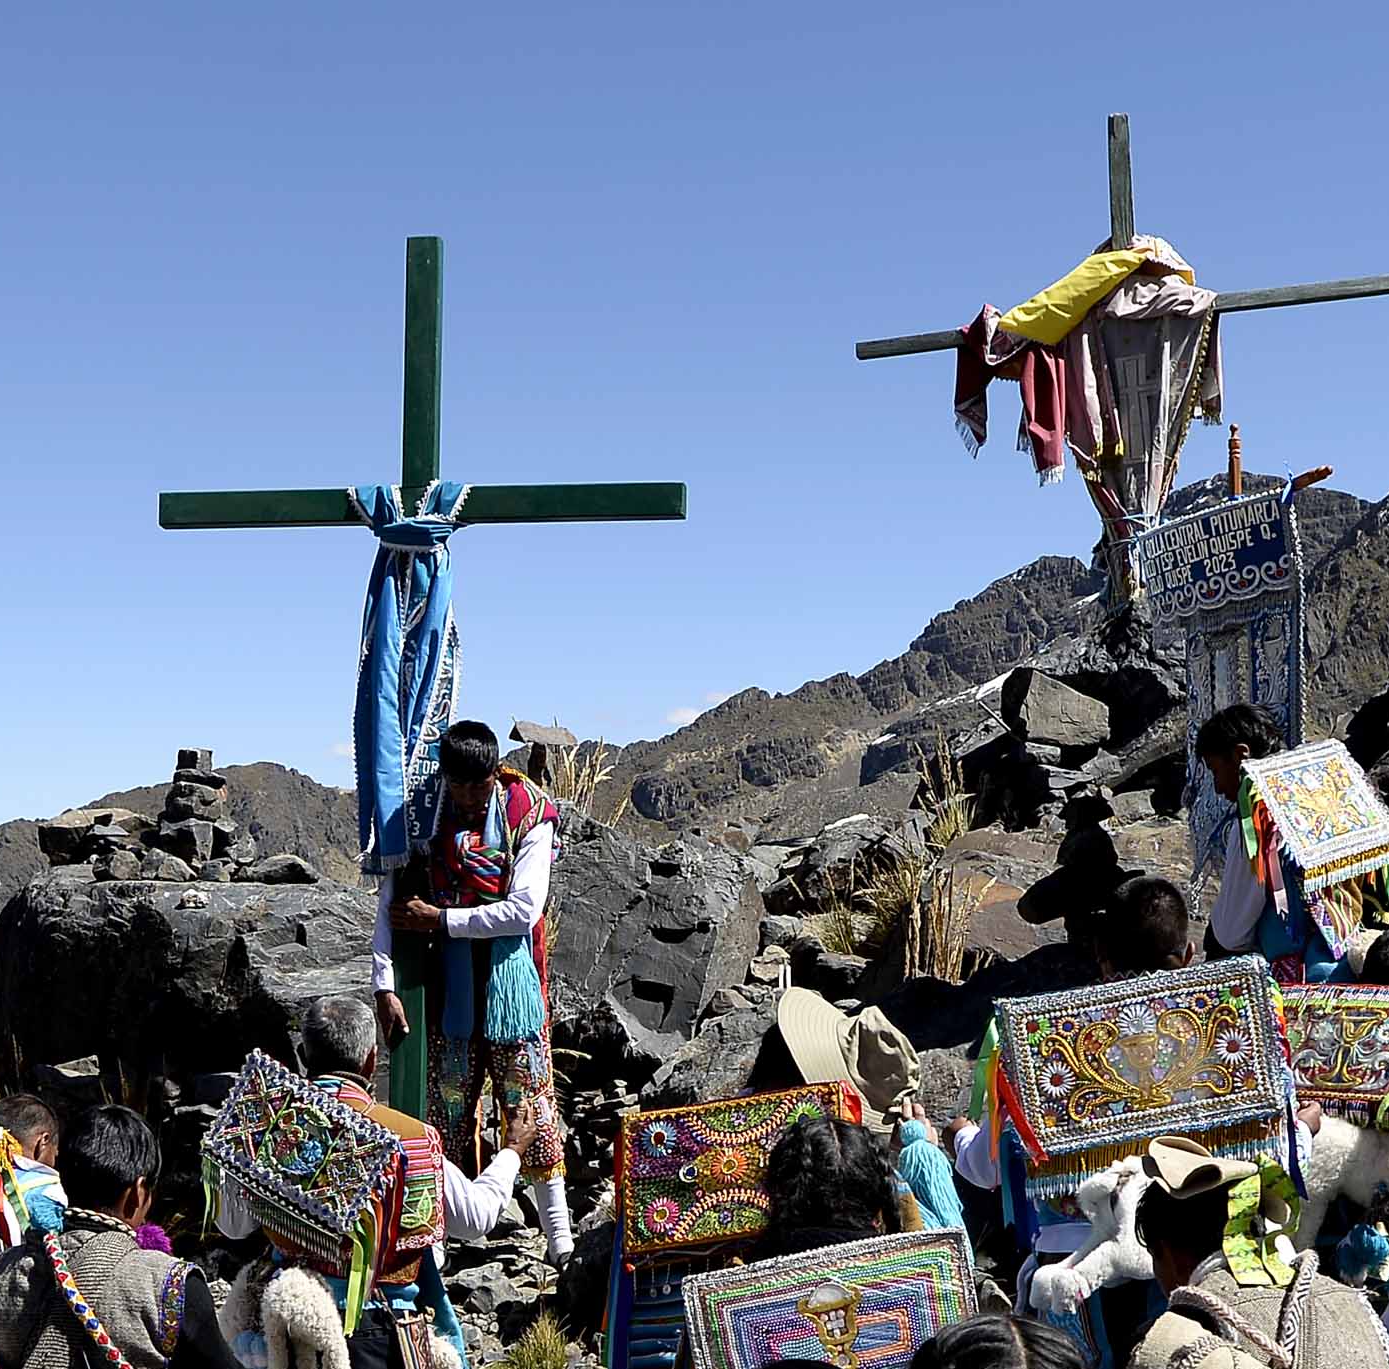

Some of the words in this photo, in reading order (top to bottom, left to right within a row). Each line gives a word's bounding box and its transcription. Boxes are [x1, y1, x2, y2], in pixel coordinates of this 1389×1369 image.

[1165, 520, 1209, 550] CENTRAL
[1210, 500, 1280, 535] PITUMARCA
[1176, 540, 1208, 564] EVELIN
[1210, 529, 1254, 556] QUISPE
[1261, 524, 1277, 540] Q.
[1165, 566, 1193, 589] QUISPE
[1204, 551, 1237, 577] 2023
